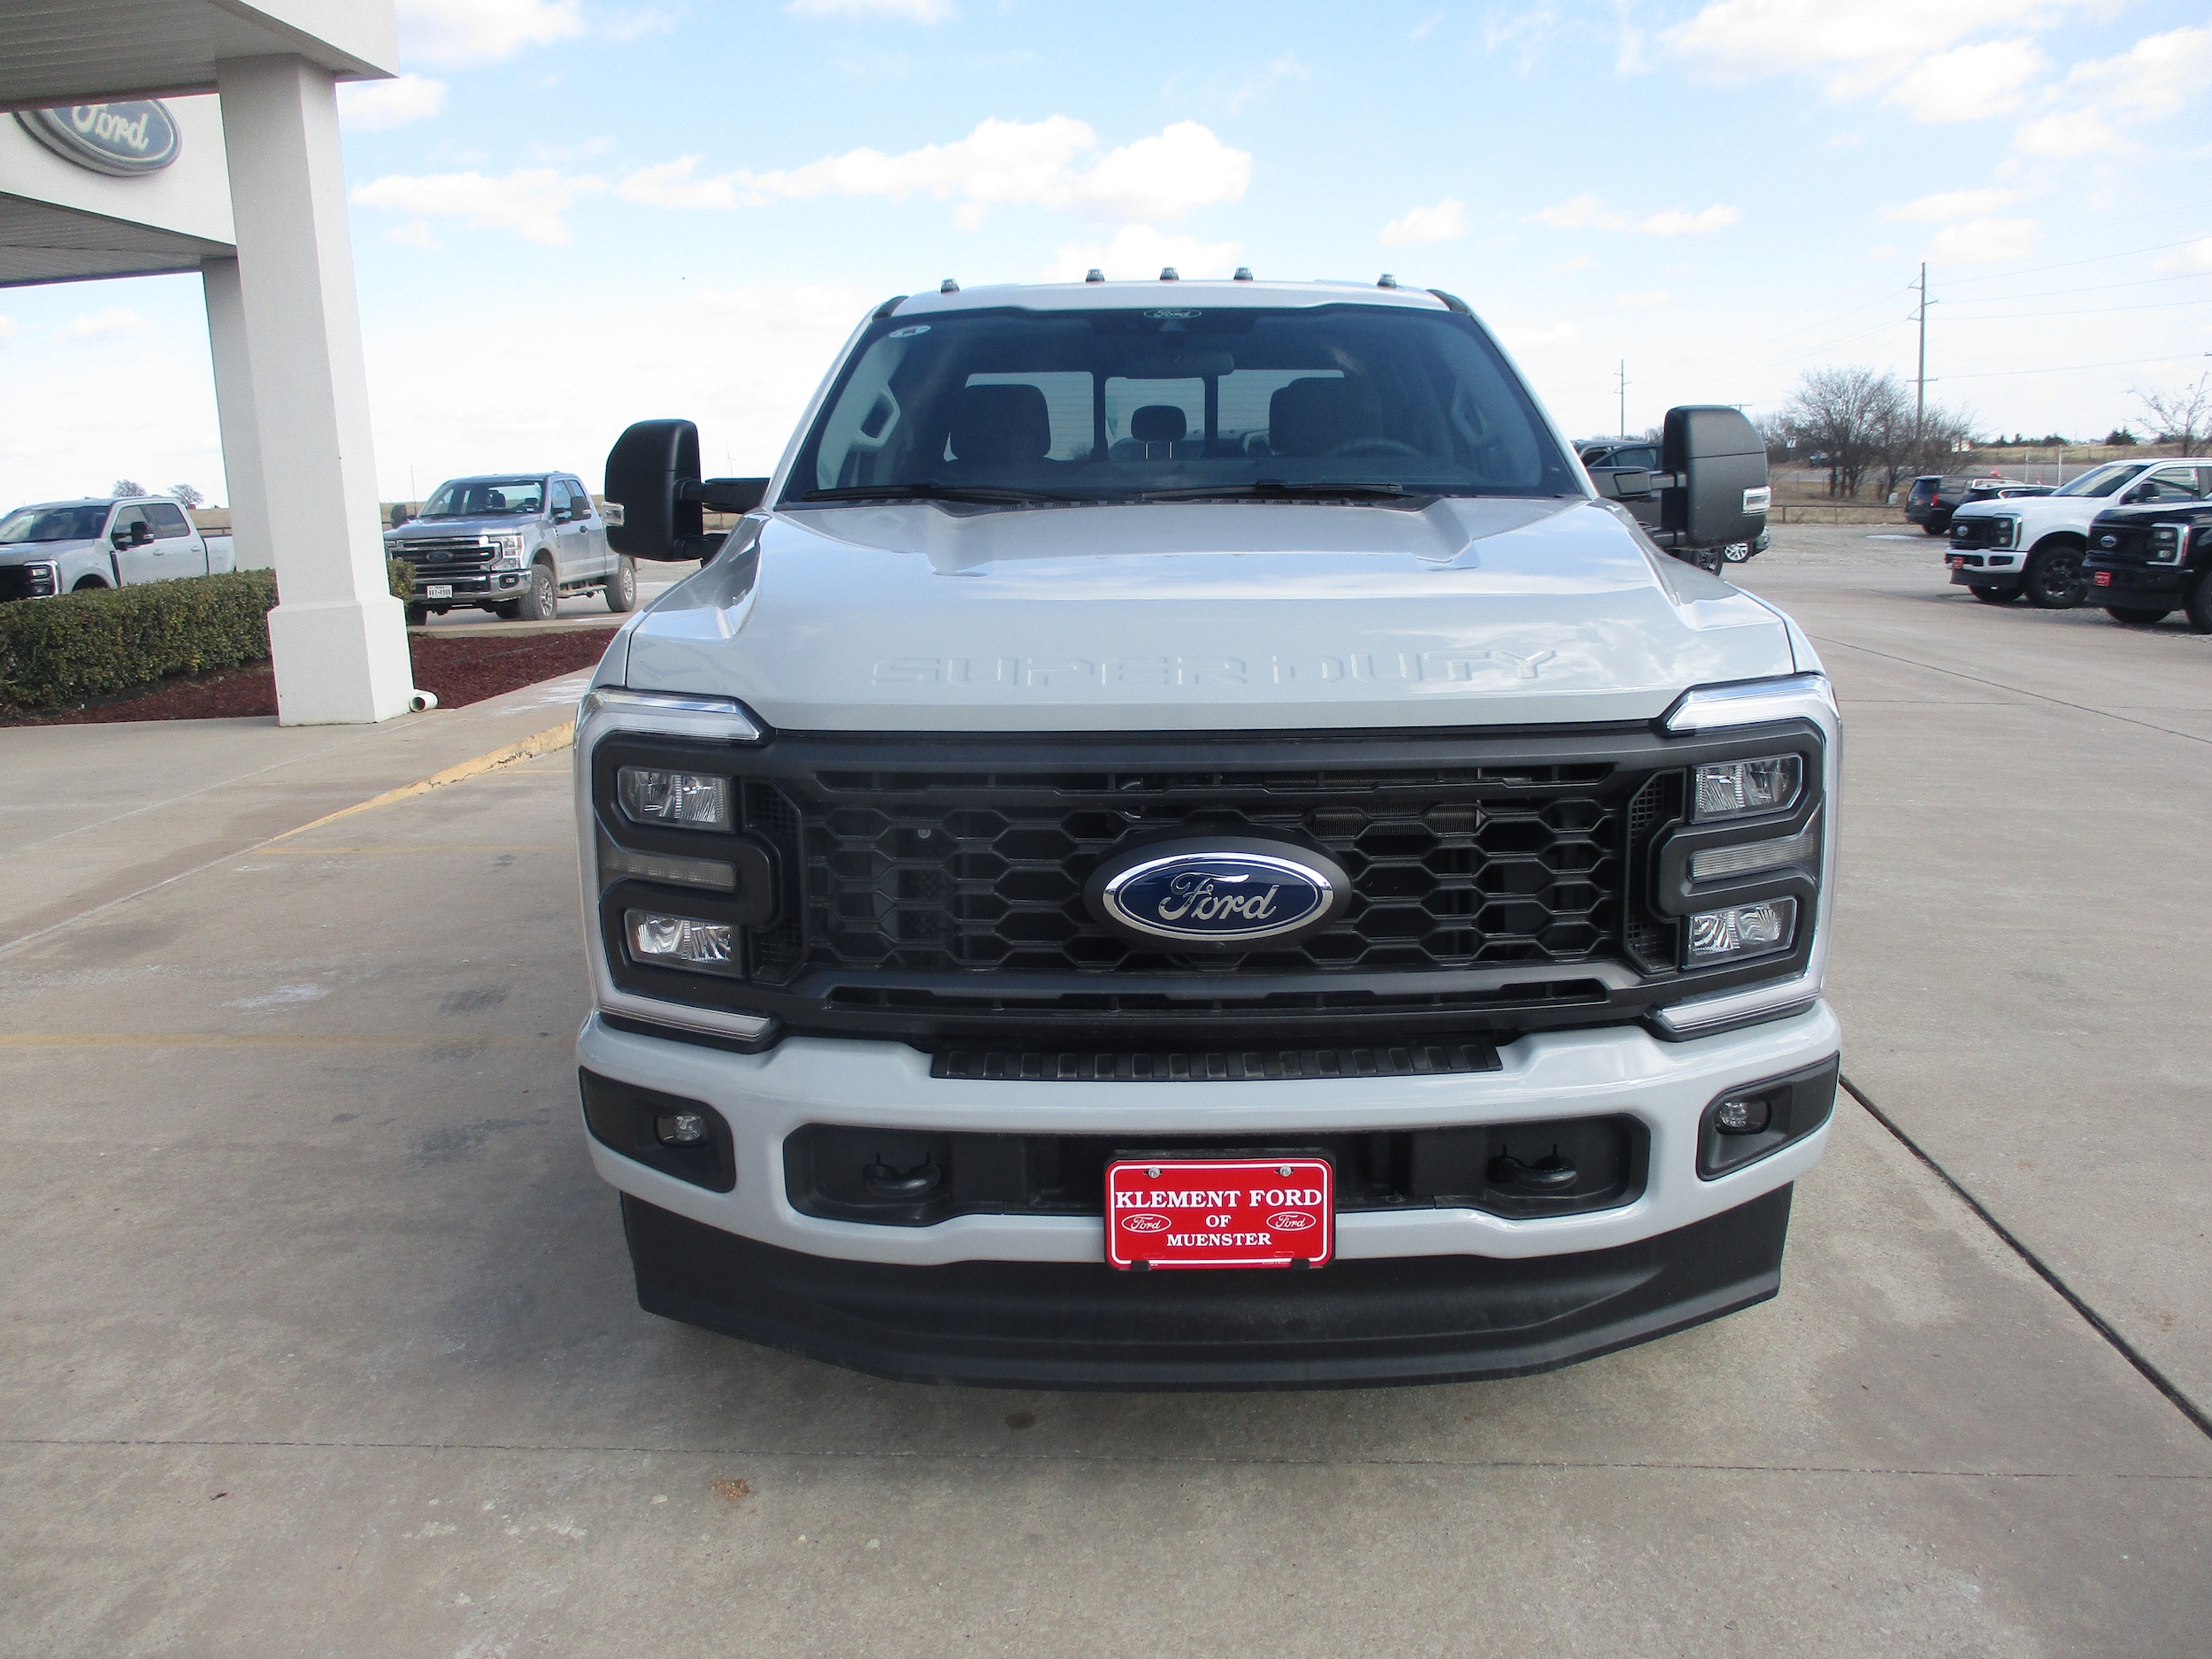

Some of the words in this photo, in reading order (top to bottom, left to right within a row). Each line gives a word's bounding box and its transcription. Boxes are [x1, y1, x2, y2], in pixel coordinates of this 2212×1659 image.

[73, 104, 149, 151] Ford
[1154, 310, 1191, 319] Ford
[871, 657, 1246, 687] SUPER
[1271, 649, 1556, 686] DUTY
[1157, 872, 1280, 921] Ford
[1115, 1190, 1241, 1209] KLEMENT
[1249, 1188, 1323, 1207] FORD
[1130, 1216, 1162, 1231] Ford
[1205, 1214, 1232, 1228] OF
[1275, 1213, 1306, 1229] Ford
[1166, 1233, 1272, 1247] MUENSTER
